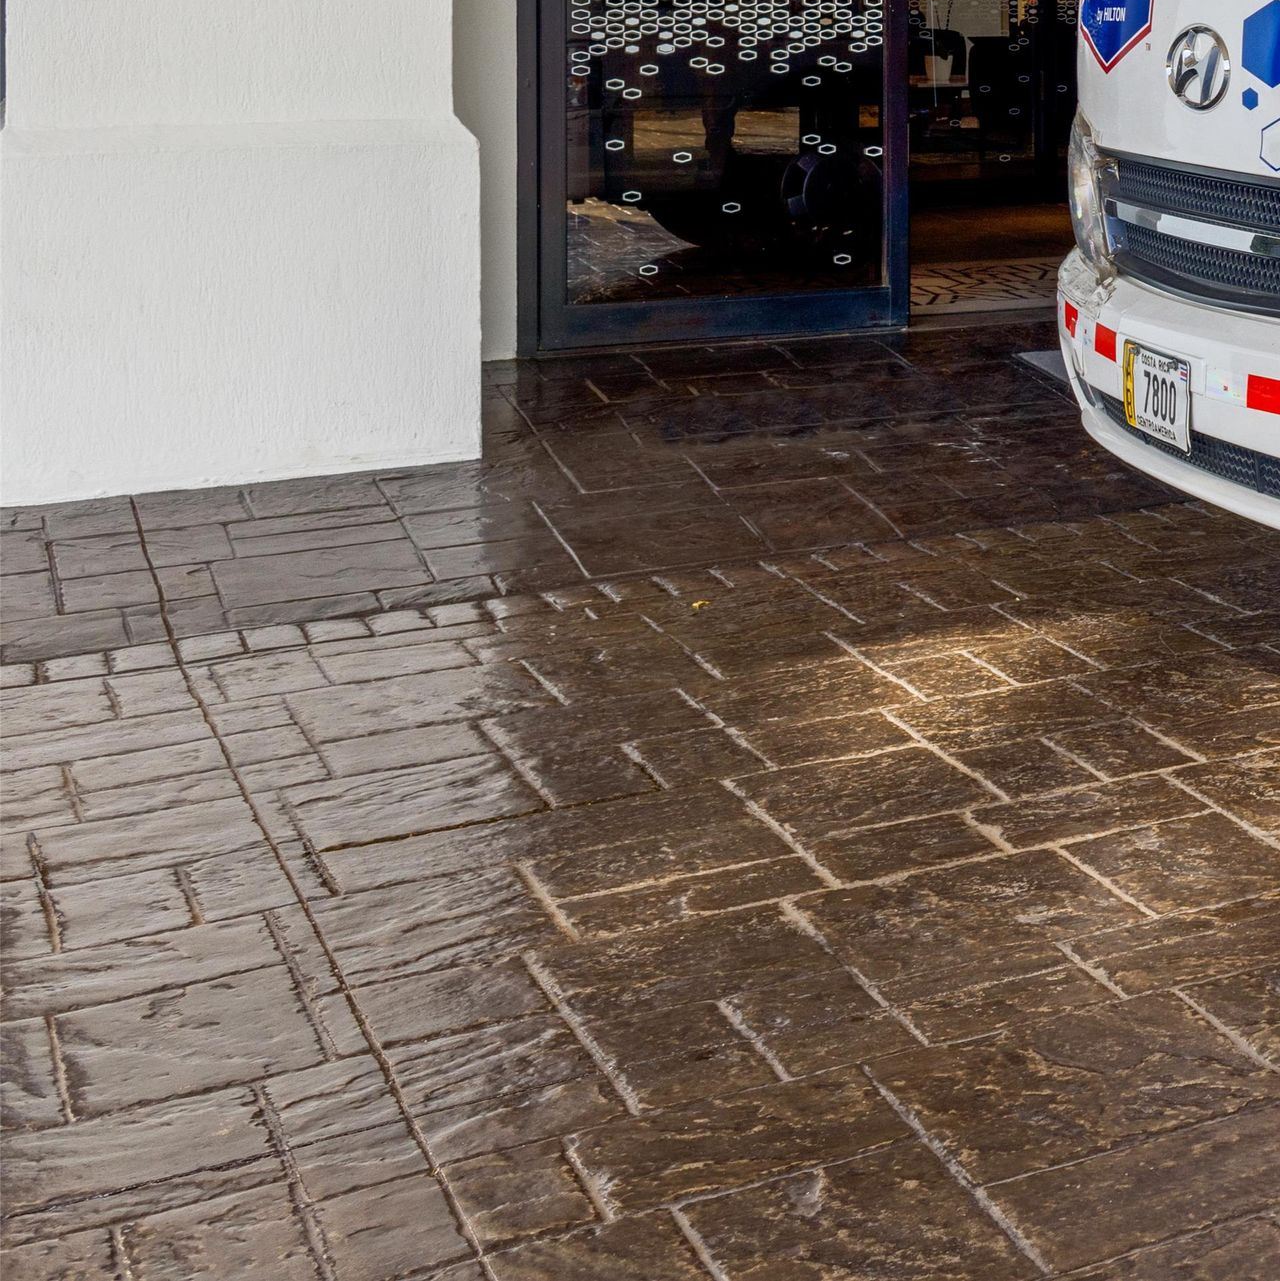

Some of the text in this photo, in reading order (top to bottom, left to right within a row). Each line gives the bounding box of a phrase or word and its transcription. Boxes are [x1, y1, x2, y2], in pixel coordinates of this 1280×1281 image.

[1104, 7, 1127, 22] HILTON
[1141, 353, 1157, 369] COSTA
[1143, 370, 1177, 425] 7800
[1137, 415, 1177, 440] CENTROAMERICA
